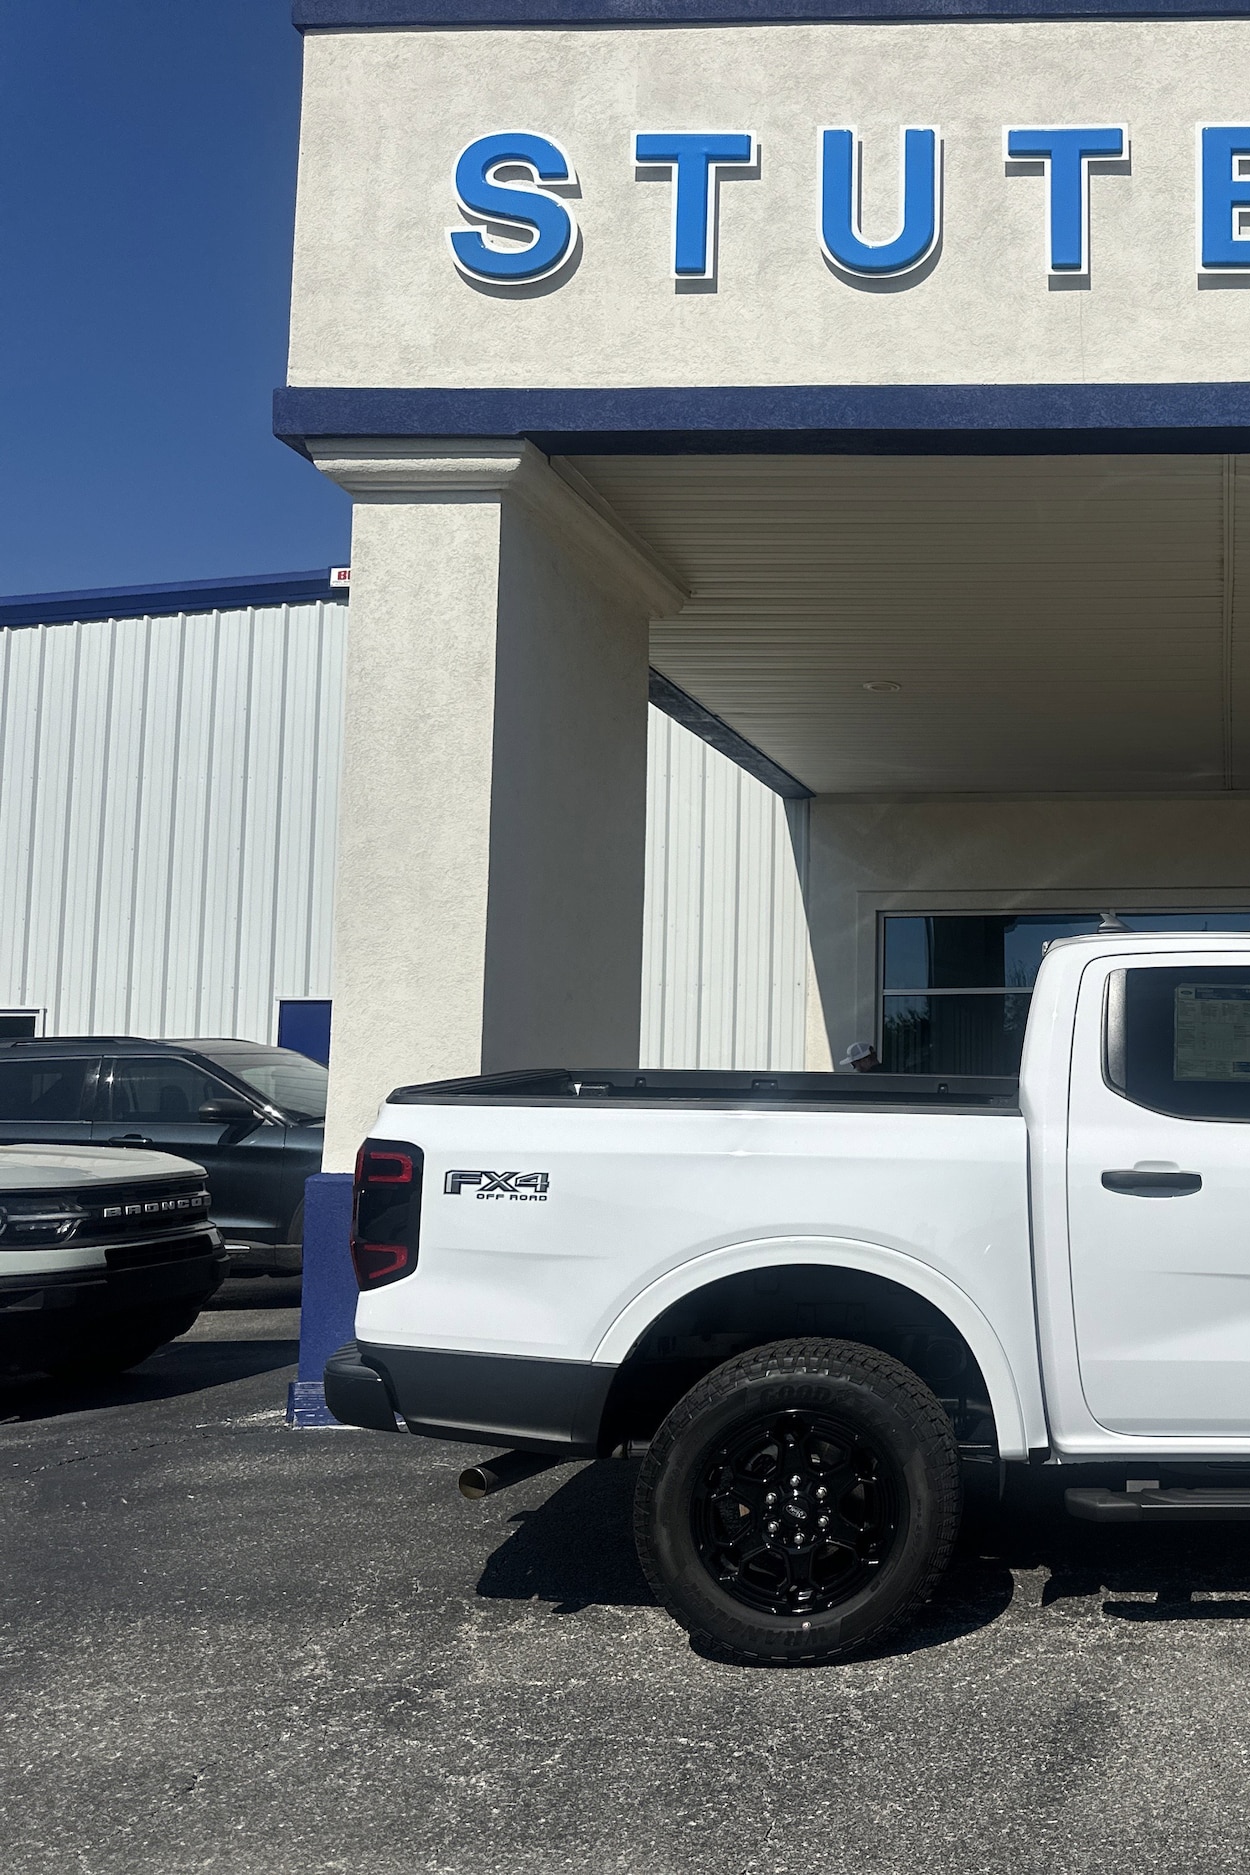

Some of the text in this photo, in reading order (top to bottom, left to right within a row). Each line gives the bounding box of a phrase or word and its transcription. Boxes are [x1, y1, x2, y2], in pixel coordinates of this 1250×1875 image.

[443, 1169, 549, 1195] FX4
[103, 1197, 204, 1218] BRONCO
[509, 1194, 548, 1202] ROAD
